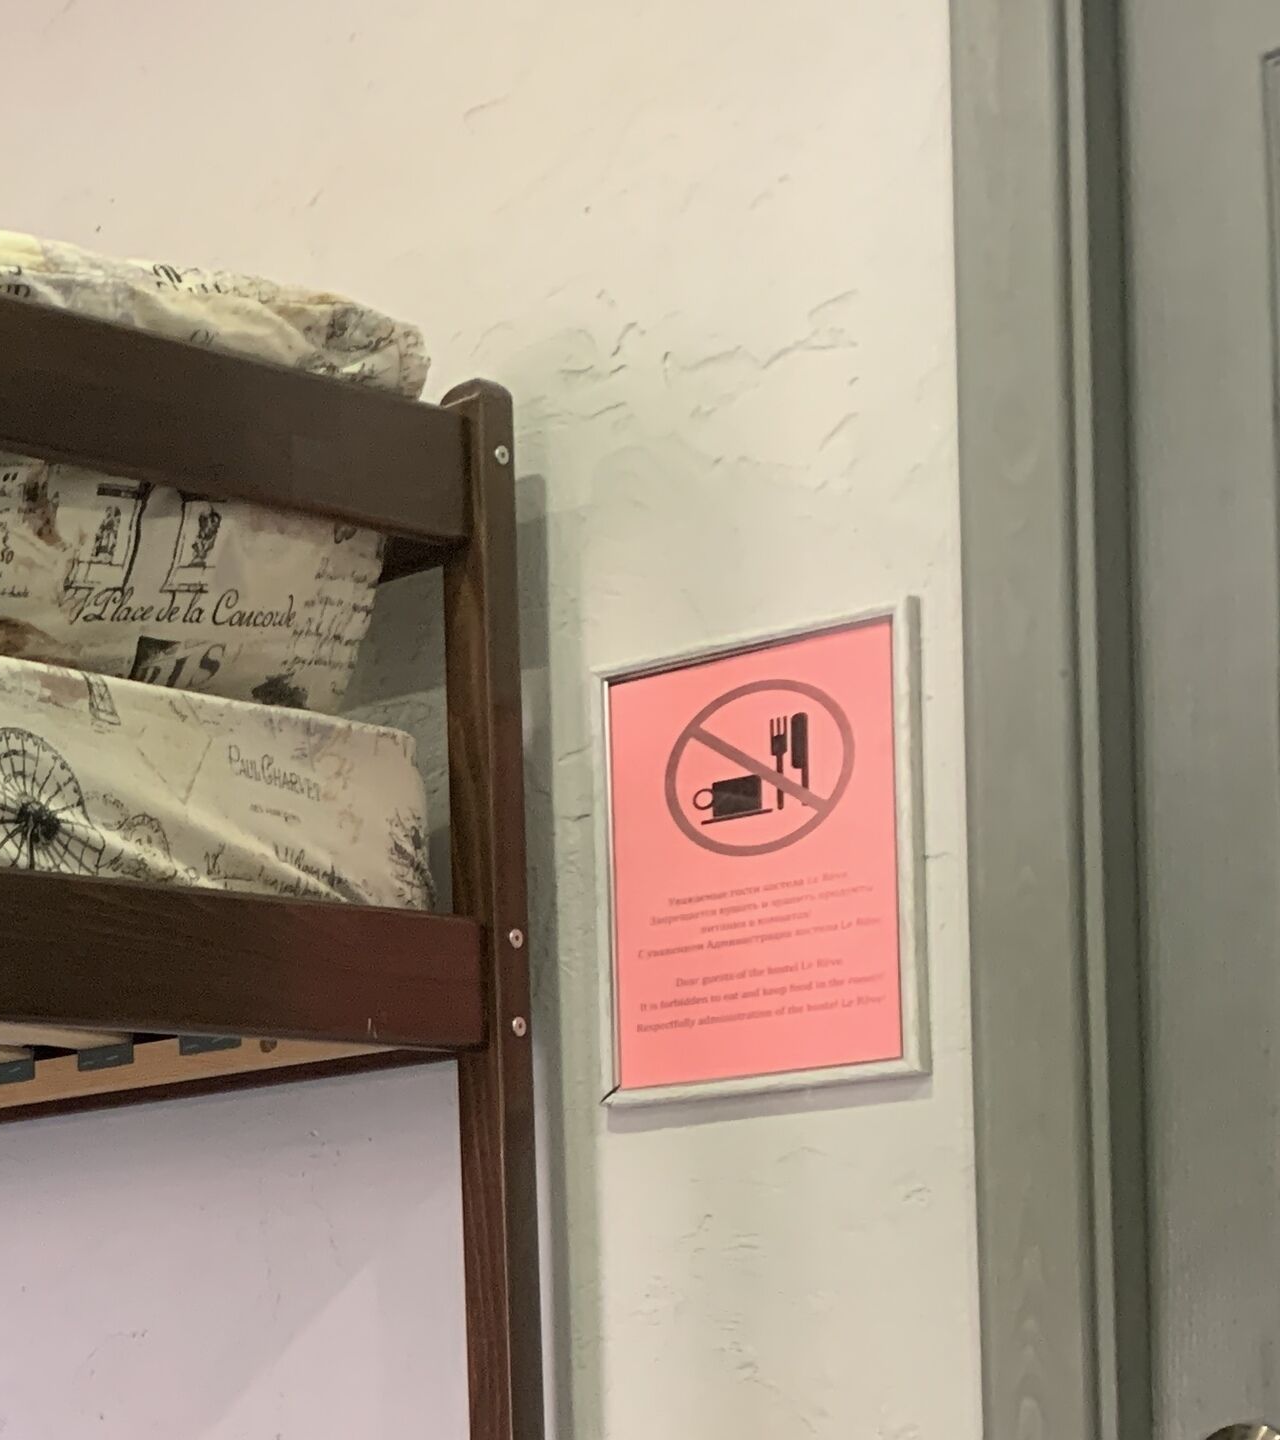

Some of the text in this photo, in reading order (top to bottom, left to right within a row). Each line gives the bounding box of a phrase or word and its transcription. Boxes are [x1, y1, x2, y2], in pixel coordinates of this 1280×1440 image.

[82, 587, 157, 625] Place
[156, 590, 179, 624] de
[182, 592, 204, 625] la
[660, 996, 708, 1009] forbidden
